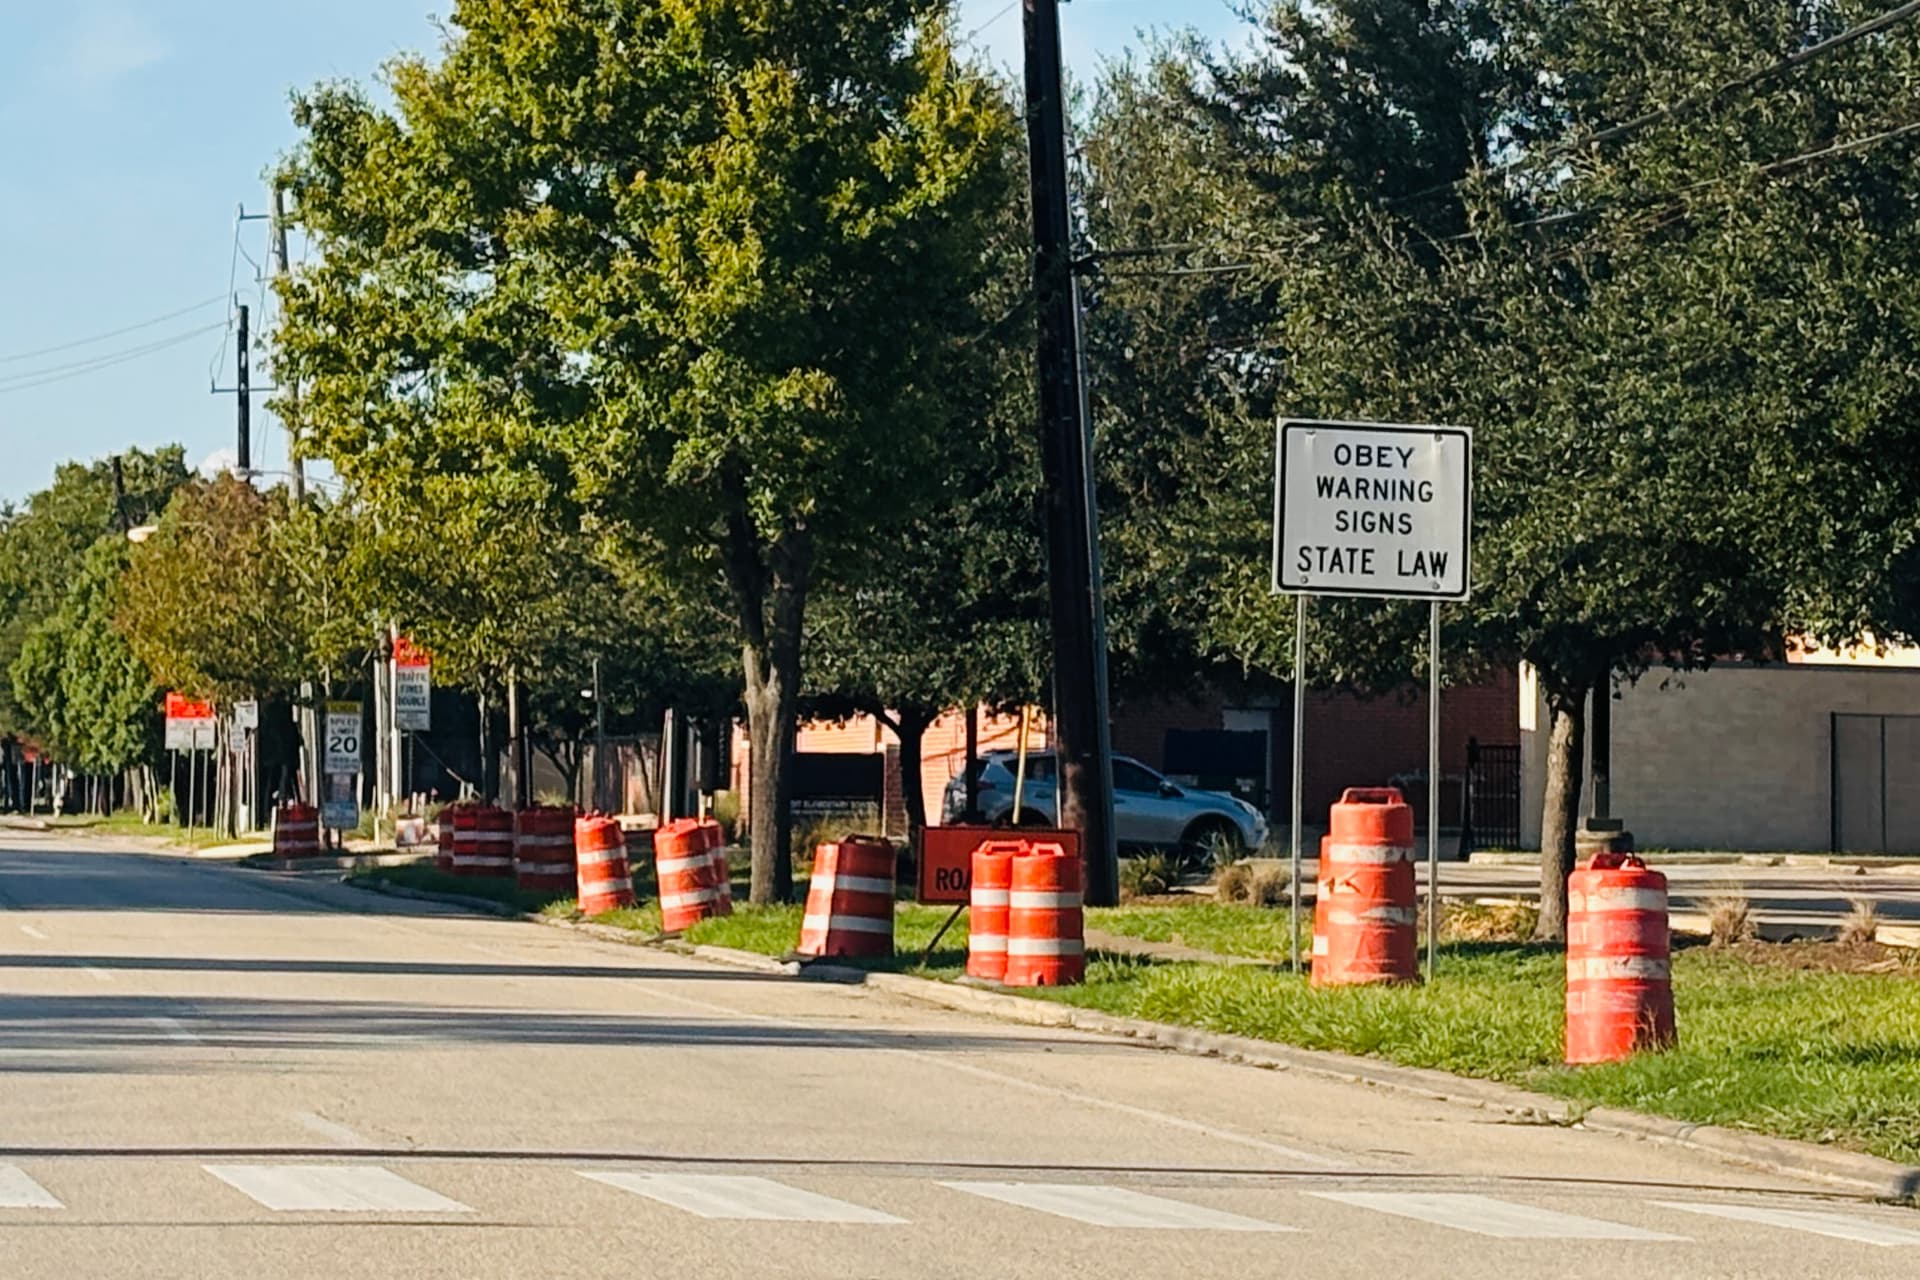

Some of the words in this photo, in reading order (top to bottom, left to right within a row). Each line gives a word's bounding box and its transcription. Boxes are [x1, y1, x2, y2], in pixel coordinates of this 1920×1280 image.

[1334, 443, 1415, 469] OBEY
[1316, 475, 1433, 503] WARNING
[1335, 510, 1413, 535] SIGNS
[1297, 546, 1375, 575] STATE
[1397, 549, 1448, 578] LAW
[330, 717, 359, 727] SPEED
[331, 727, 356, 736] LIMIT
[329, 736, 358, 754] 20
